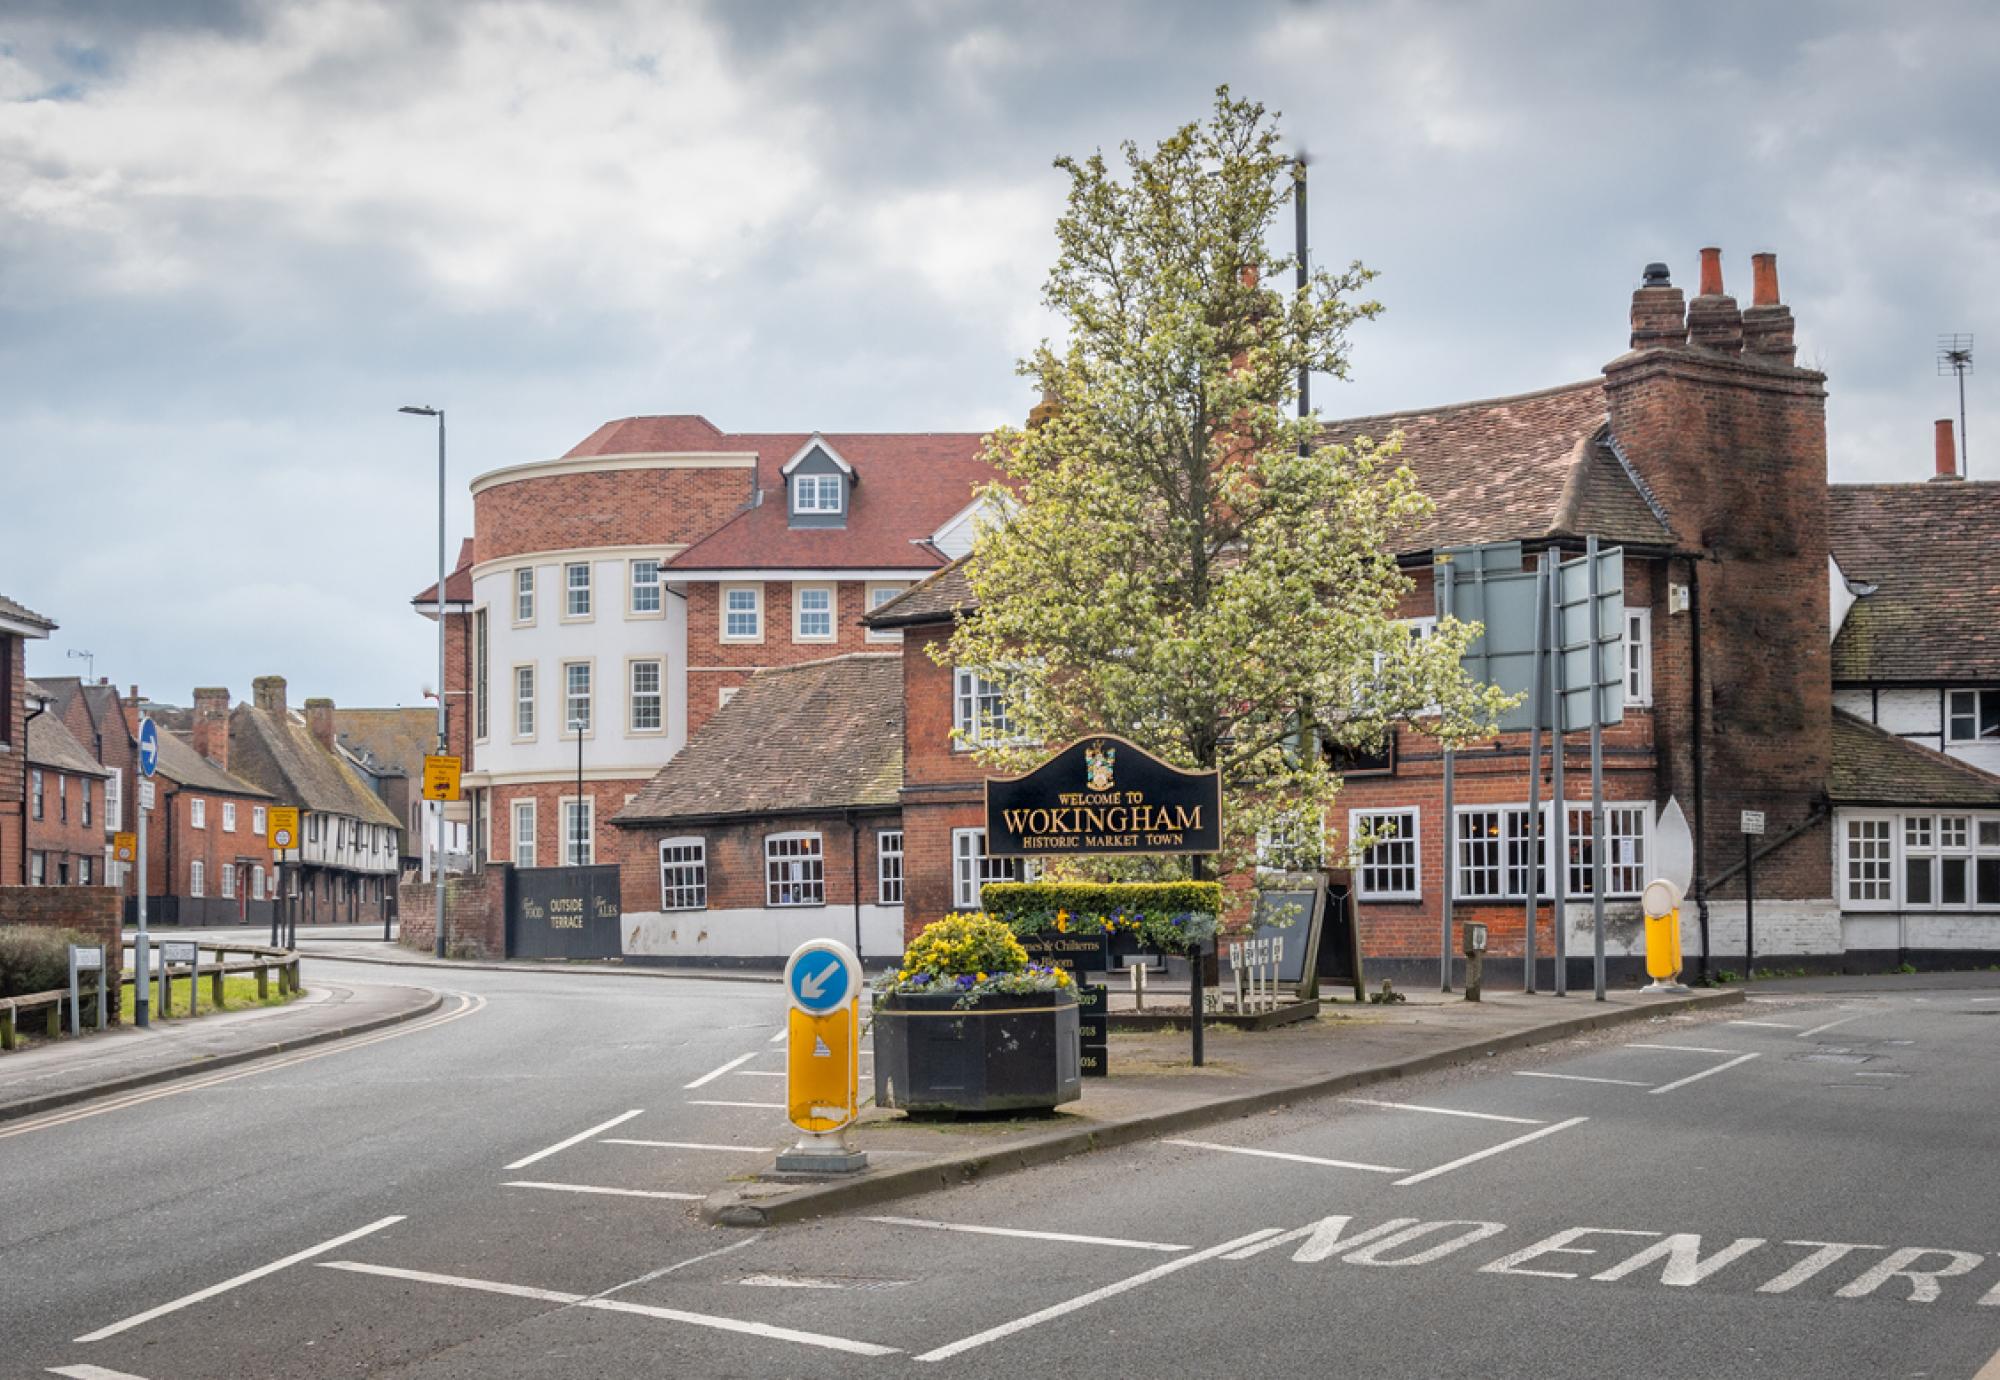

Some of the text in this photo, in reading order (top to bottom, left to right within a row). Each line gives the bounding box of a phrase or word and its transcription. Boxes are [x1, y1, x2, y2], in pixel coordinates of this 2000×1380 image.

[1058, 791, 1143, 806] WELCOME TO
[1002, 804, 1204, 834] WOKINGHAM
[1023, 833, 1183, 848] HISTORIC MARKET TOWN
[550, 898, 583, 912] OUTSIDE
[550, 914, 583, 929] TERRACE
[1080, 1026, 1097, 1037] 018
[1080, 1056, 1098, 1067] 016
[1222, 1214, 2000, 1306] NO ENTR
